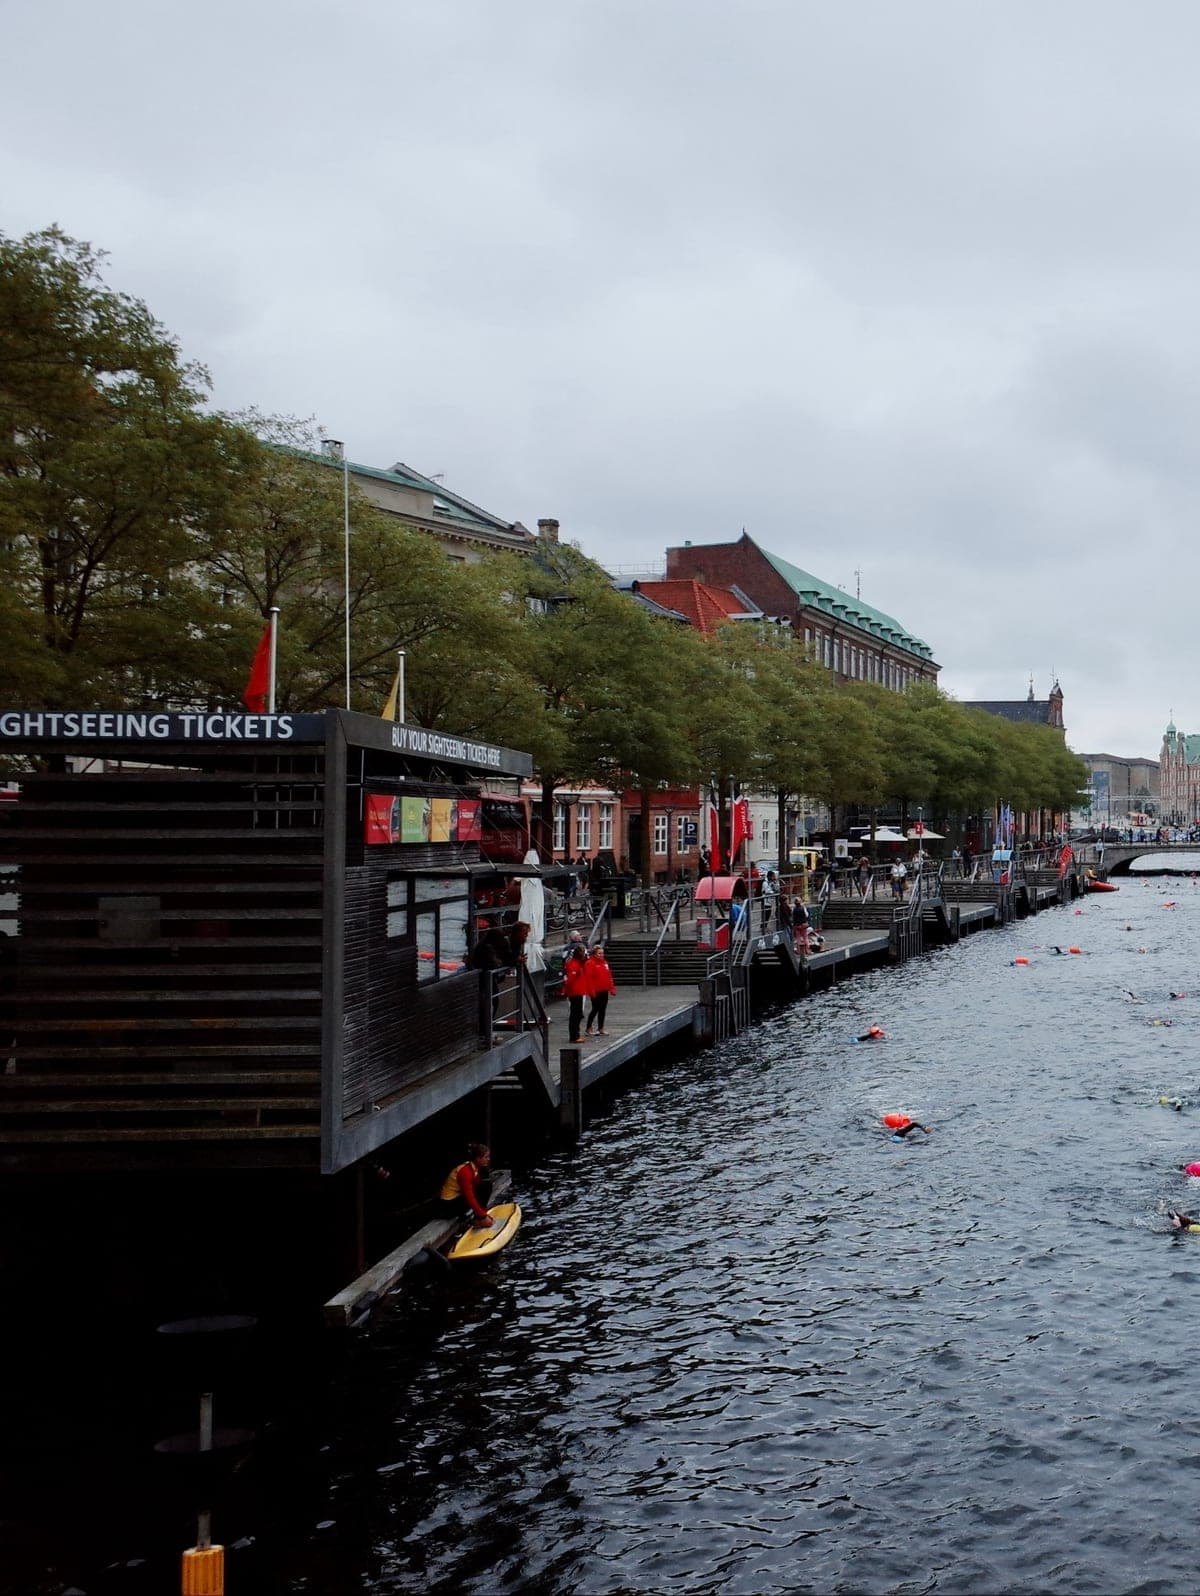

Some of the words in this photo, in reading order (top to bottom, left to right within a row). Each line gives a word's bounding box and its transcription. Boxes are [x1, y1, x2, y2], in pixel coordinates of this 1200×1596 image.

[0, 713, 169, 737] GHTSEEING
[179, 715, 293, 738] TICKETS
[392, 727, 407, 748] BUY
[408, 730, 427, 752] YOUR
[428, 734, 466, 759] SIGHTSEEING
[467, 743, 487, 763] TICKETS
[488, 748, 500, 766] HERE
[687, 823, 696, 835] P
